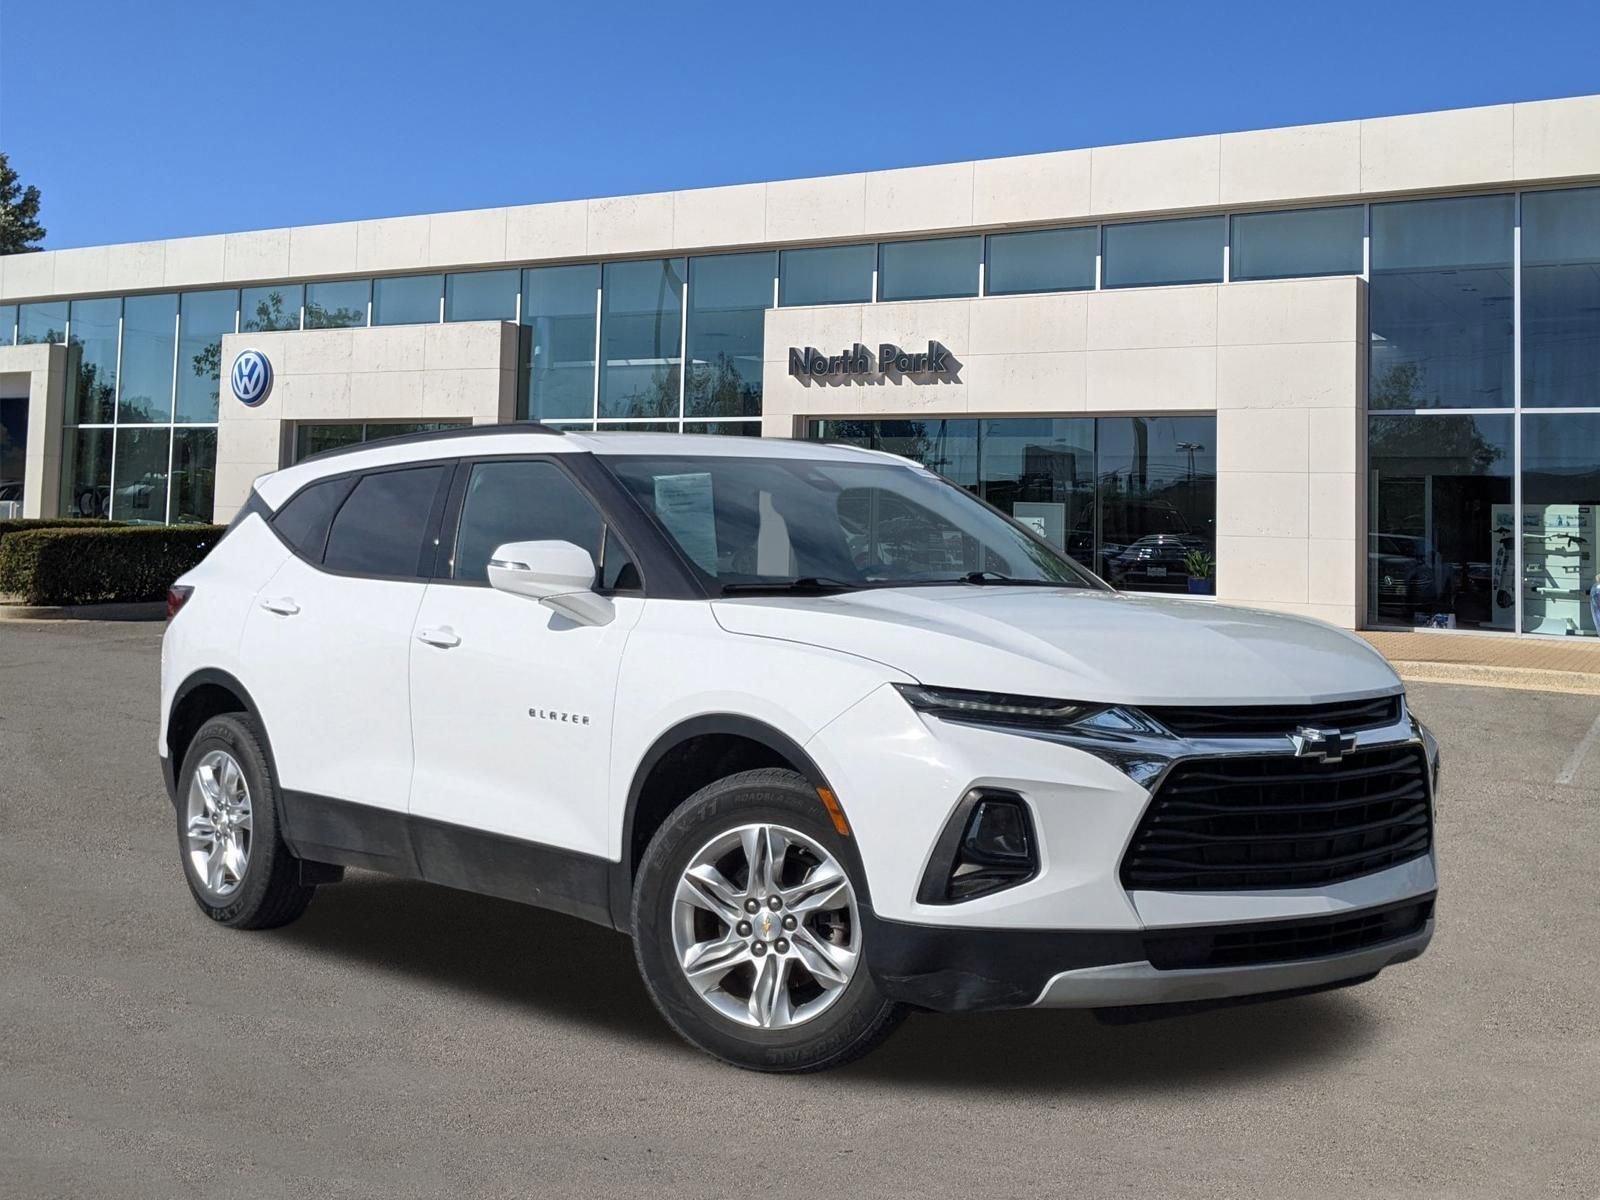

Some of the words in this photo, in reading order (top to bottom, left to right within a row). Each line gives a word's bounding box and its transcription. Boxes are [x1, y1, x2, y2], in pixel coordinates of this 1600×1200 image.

[232, 351, 267, 401] VW
[788, 342, 872, 376] North
[878, 339, 947, 374] Park
[528, 707, 590, 726] BLAZER
